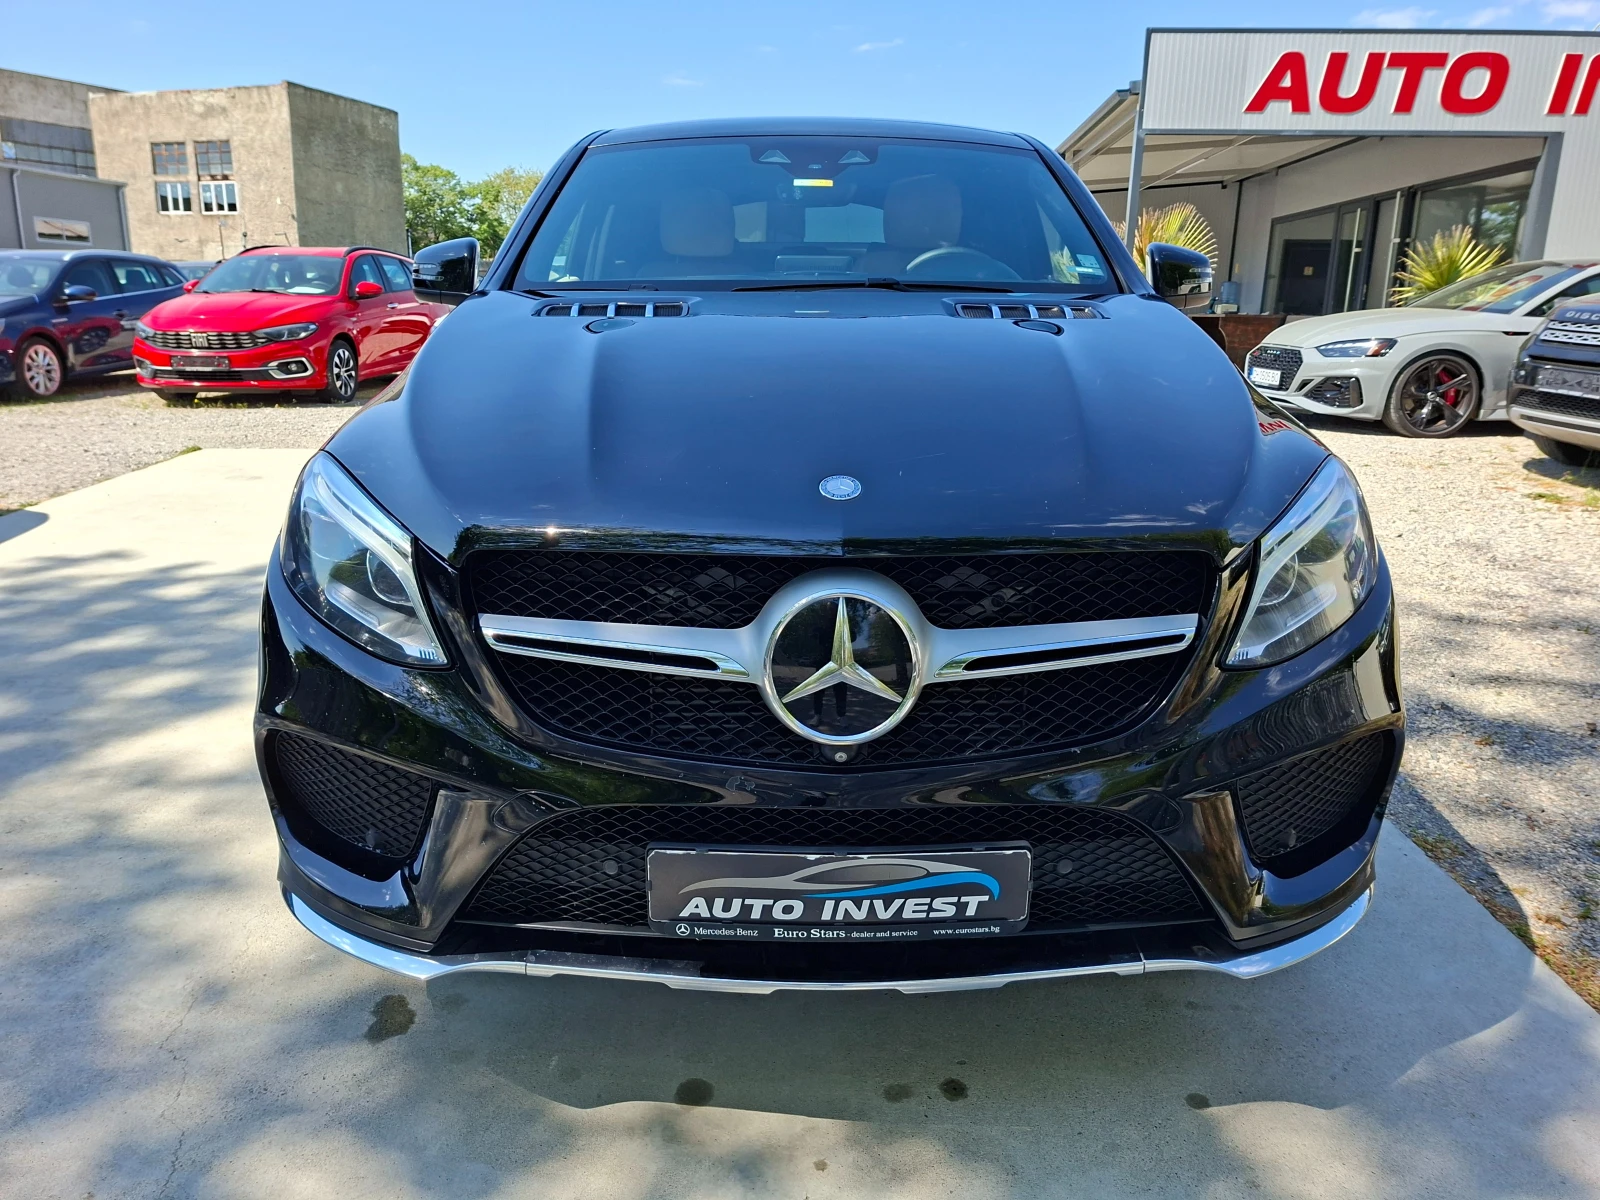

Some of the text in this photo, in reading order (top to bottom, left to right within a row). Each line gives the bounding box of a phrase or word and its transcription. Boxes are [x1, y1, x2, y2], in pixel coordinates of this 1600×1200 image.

[1243, 50, 1510, 117] AUTO
[679, 895, 990, 921] AUTO INVEST
[694, 926, 759, 936] Mercedes-Benz
[773, 928, 807, 938] Euro
[810, 928, 846, 938] Stars
[891, 929, 918, 937] service
[933, 925, 1000, 935] www.eurostars.bg
